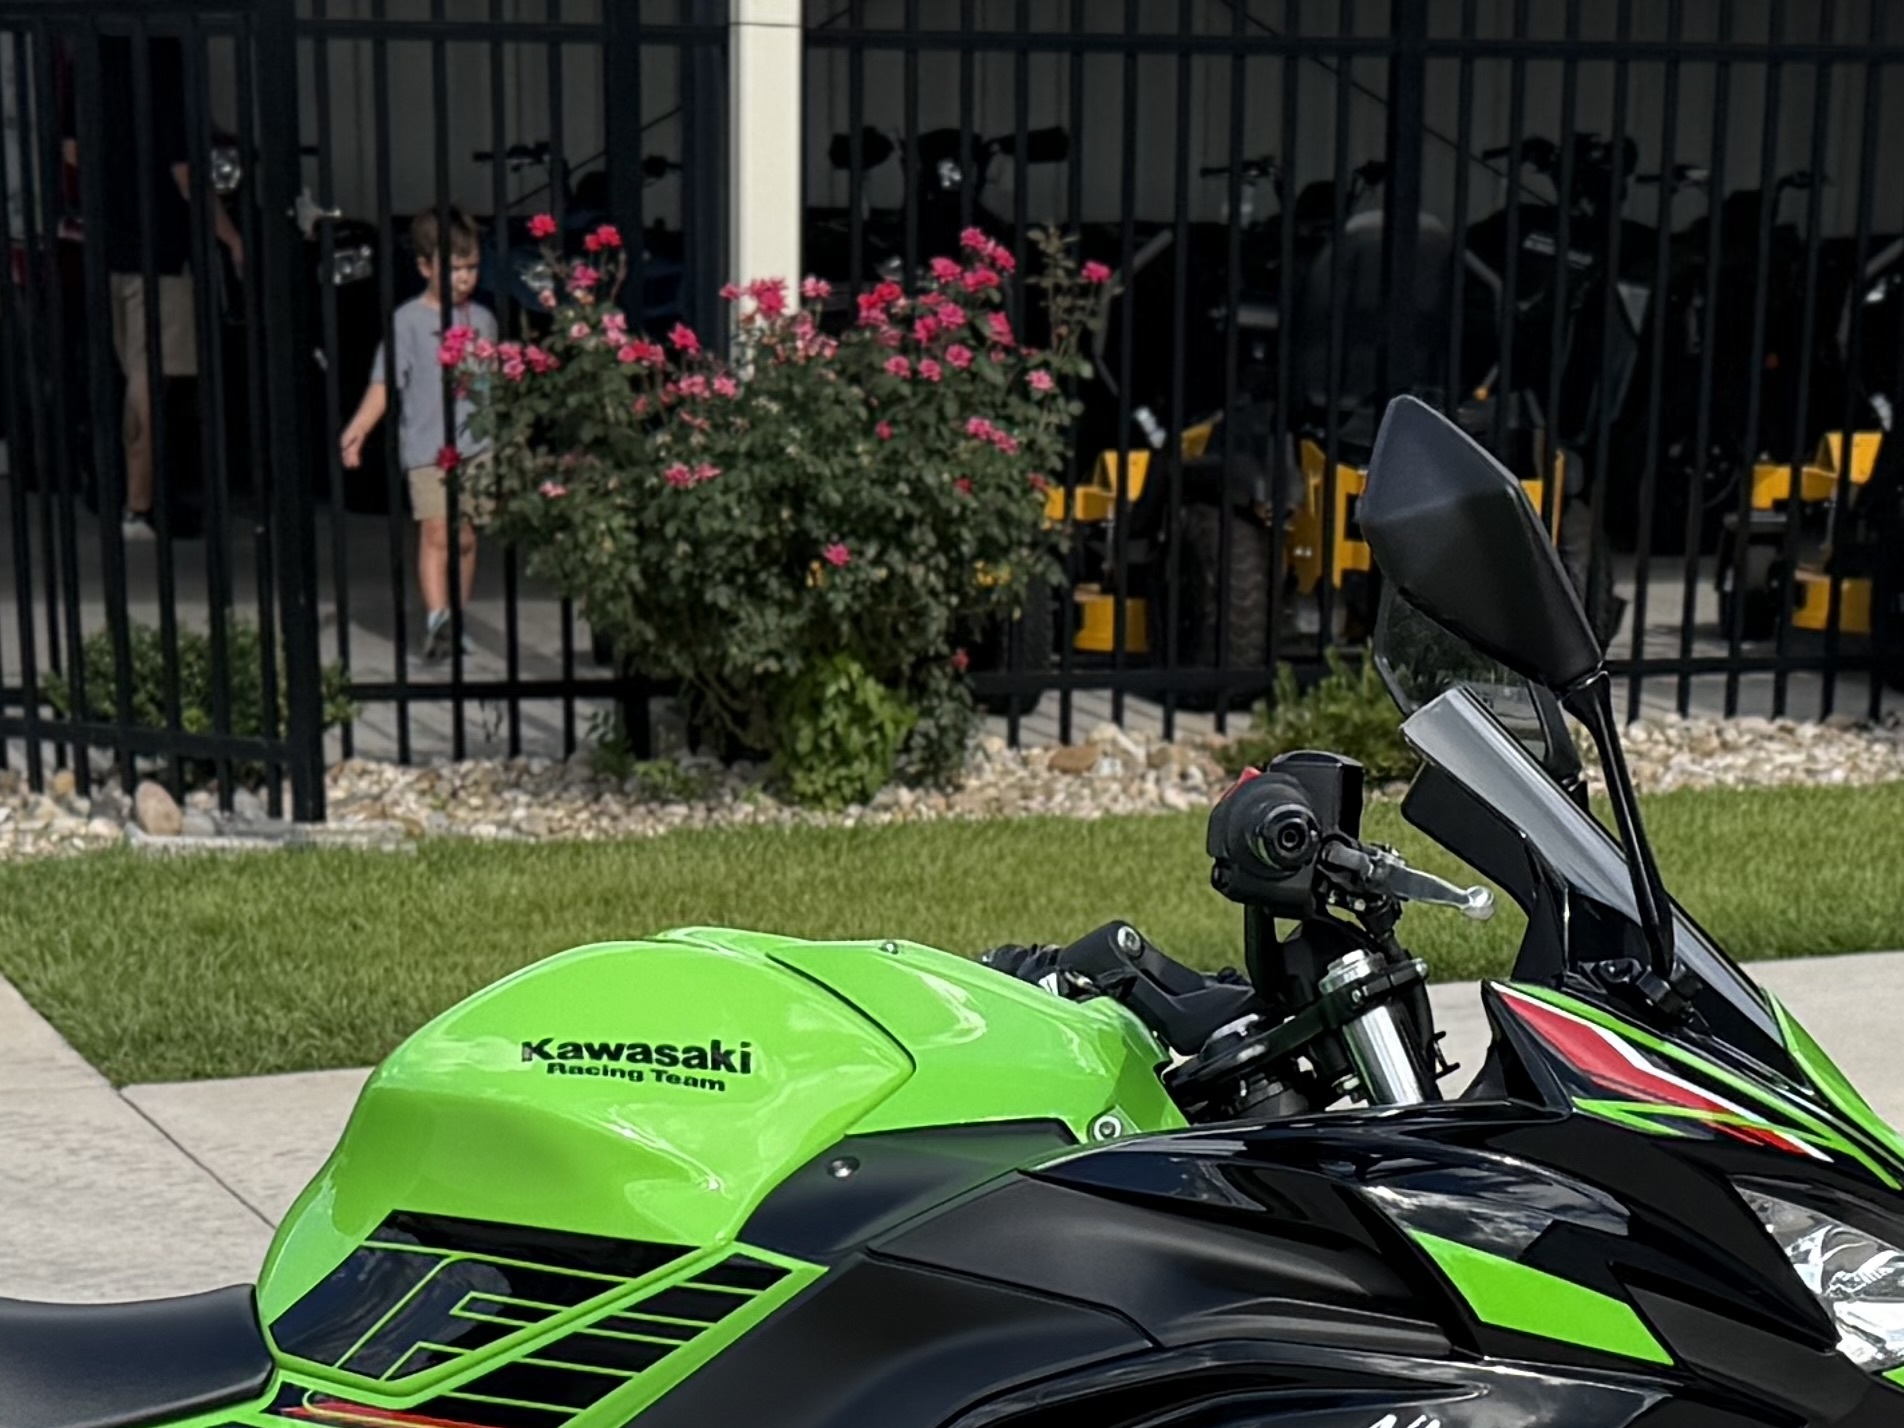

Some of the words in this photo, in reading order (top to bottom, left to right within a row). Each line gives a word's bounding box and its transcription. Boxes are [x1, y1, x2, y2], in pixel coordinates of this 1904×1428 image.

[521, 1037, 753, 1075] Kawasaki
[546, 1061, 645, 1082] Racing
[650, 1068, 726, 1092] Team
